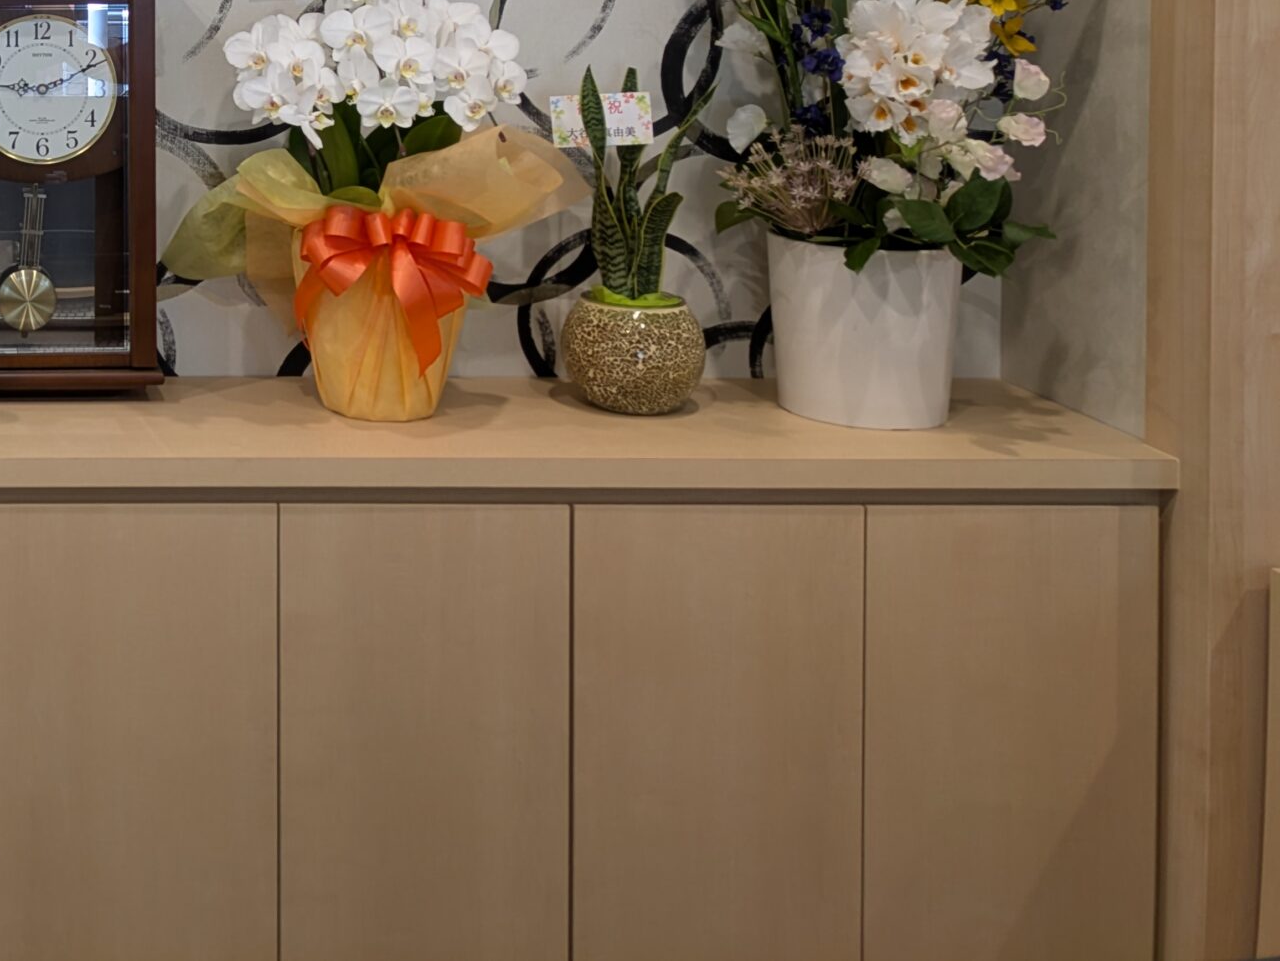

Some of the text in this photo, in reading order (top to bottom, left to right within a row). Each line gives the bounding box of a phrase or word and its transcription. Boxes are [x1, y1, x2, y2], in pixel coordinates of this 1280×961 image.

[5, 29, 19, 48] 11
[33, 21, 51, 40] 12
[68, 30, 74, 47] 1
[85, 49, 97, 67] 2
[94, 79, 106, 99] 3
[84, 109, 97, 128] 4
[8, 131, 20, 149] 7
[36, 137, 49, 157] 6
[66, 130, 78, 149] 5
